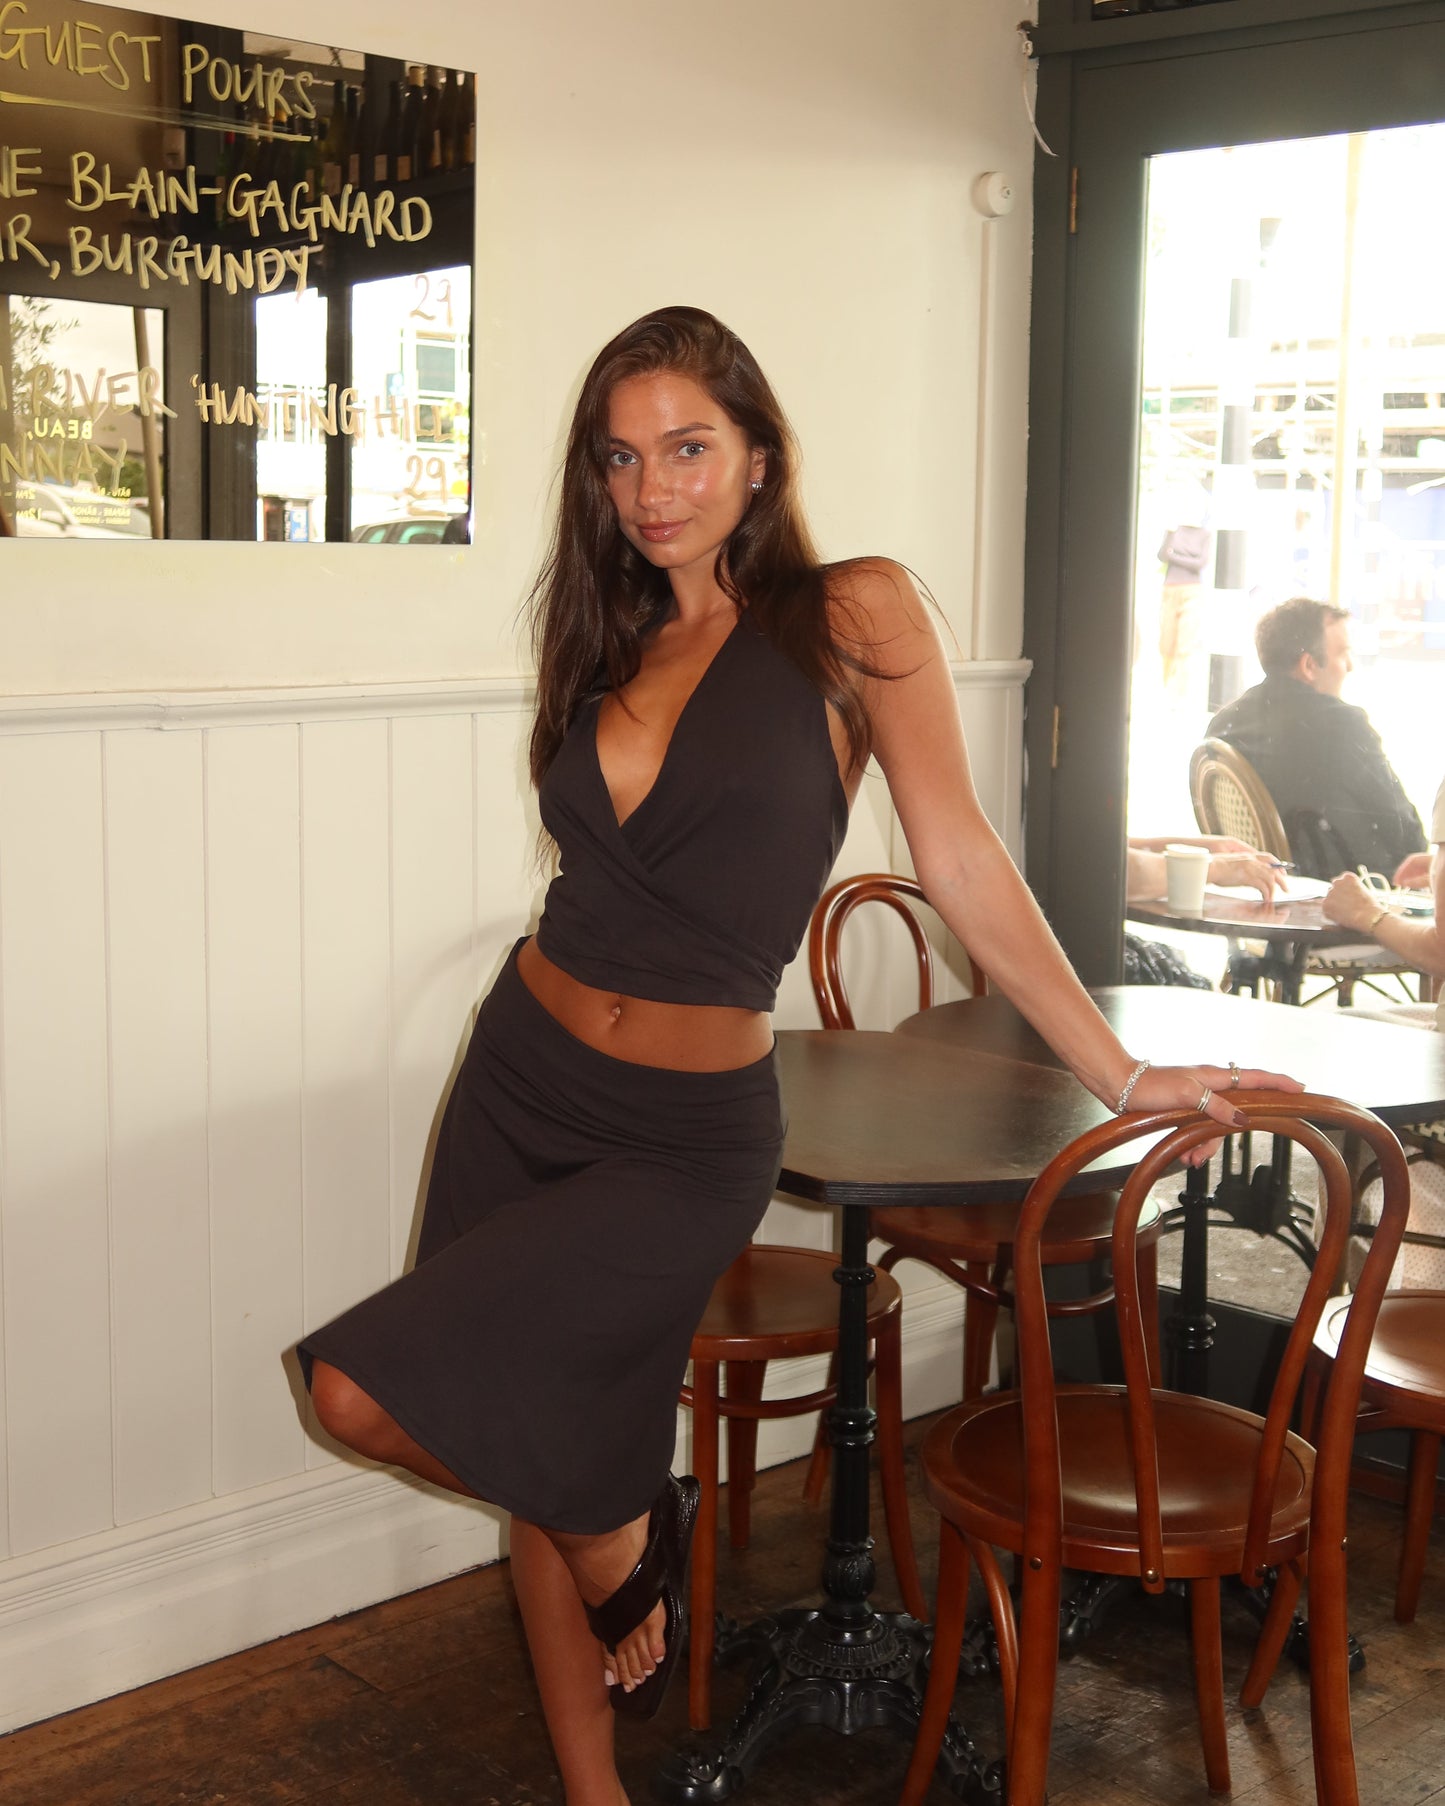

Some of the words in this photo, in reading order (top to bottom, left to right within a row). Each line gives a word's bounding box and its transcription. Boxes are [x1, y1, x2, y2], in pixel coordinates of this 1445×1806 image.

[0, 1, 161, 91] GUEST
[183, 43, 317, 120] POURS
[66, 151, 433, 249] BLAIN-GAGNARD
[0, 213, 61, 281] R,
[68, 226, 310, 303] BURGUNDY
[409, 273, 454, 328] 29
[27, 363, 179, 419] RIVER
[403, 454, 449, 504] 29
